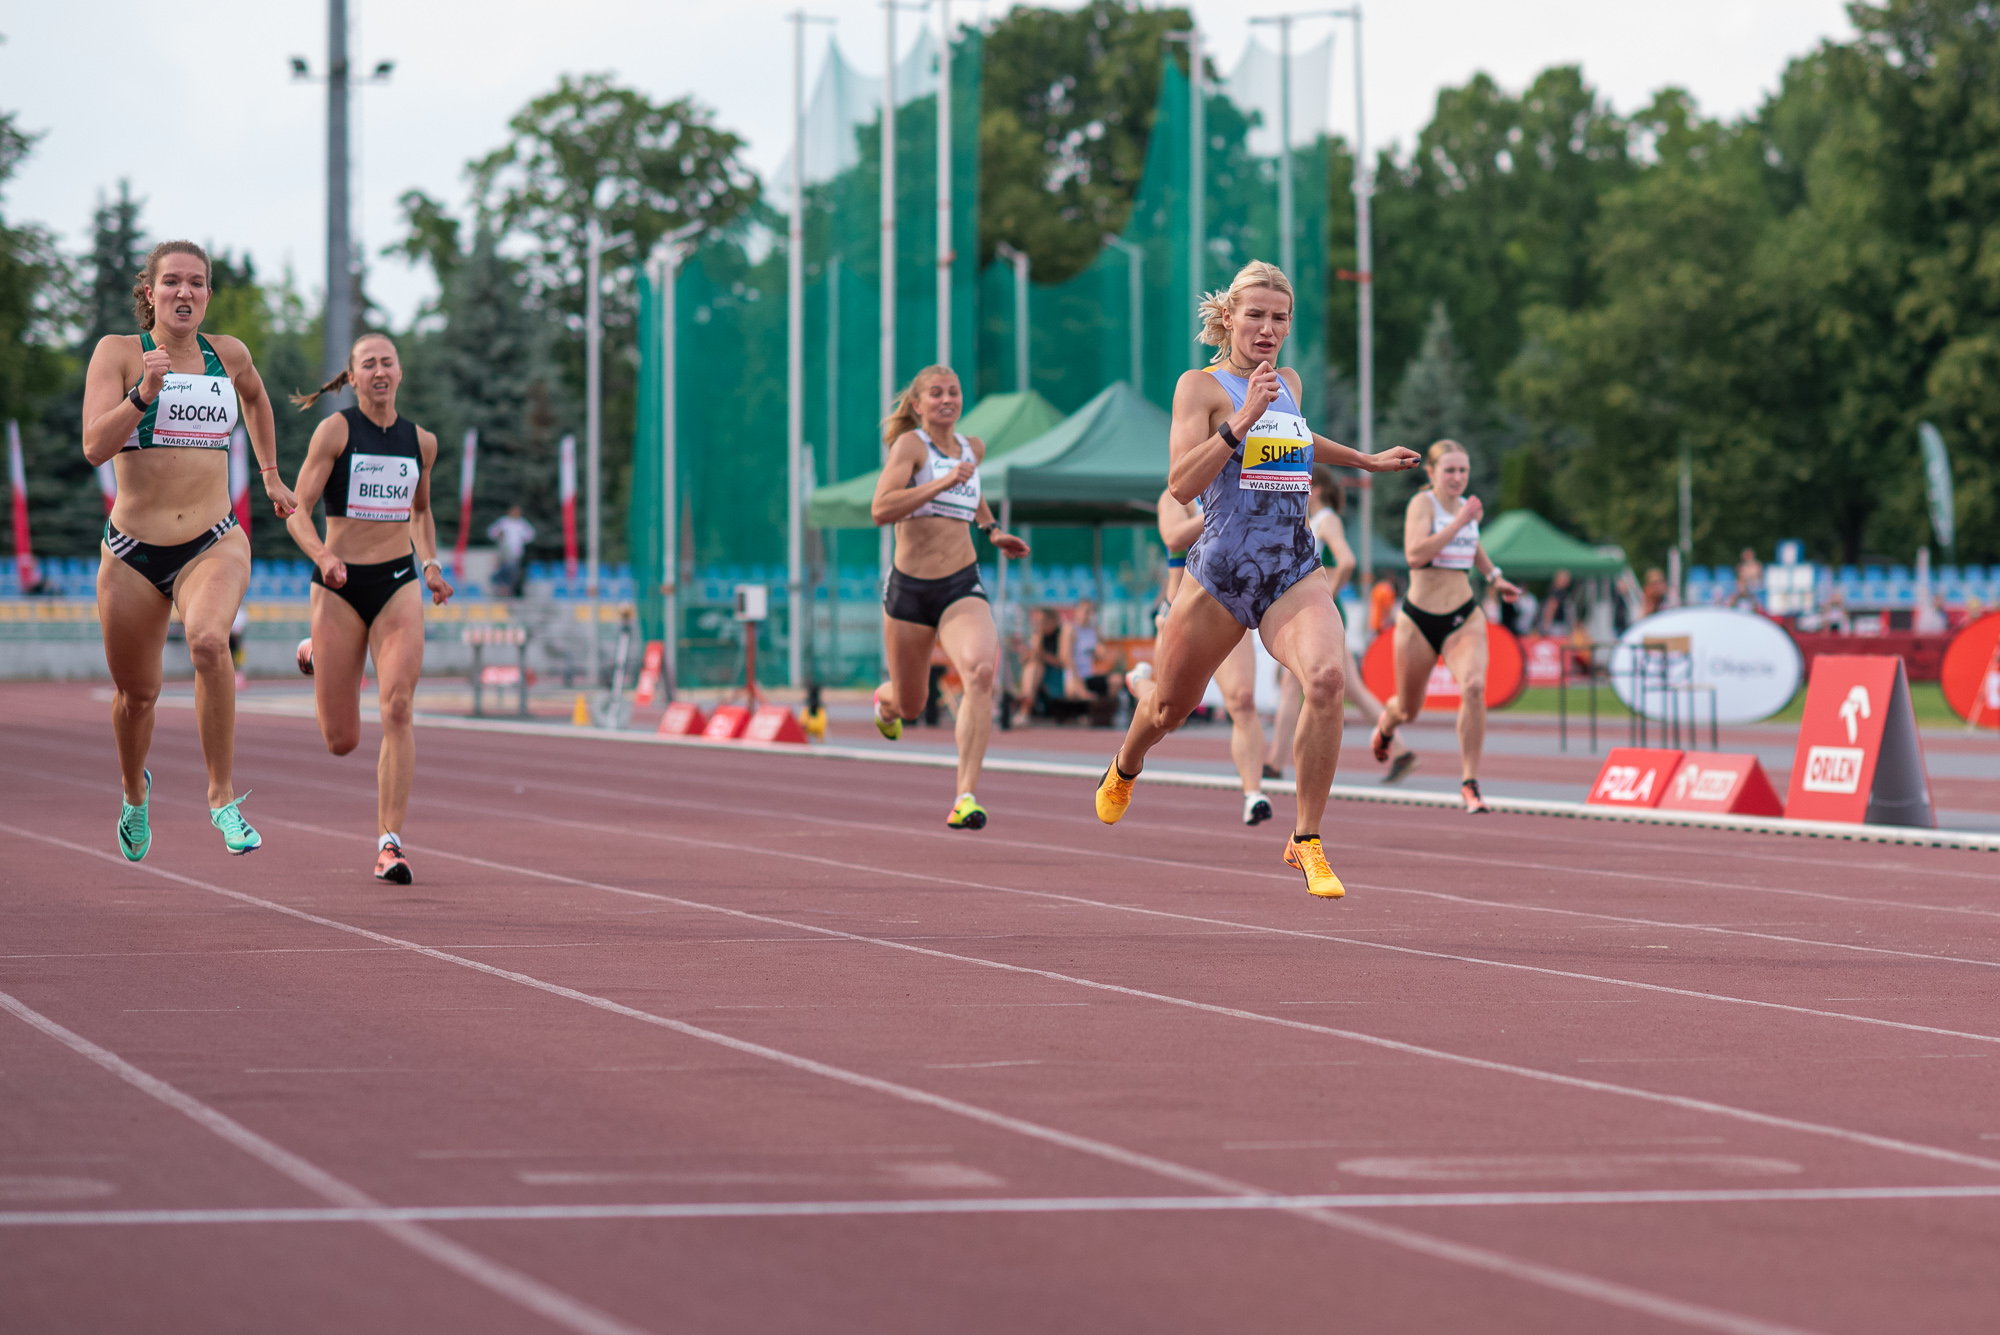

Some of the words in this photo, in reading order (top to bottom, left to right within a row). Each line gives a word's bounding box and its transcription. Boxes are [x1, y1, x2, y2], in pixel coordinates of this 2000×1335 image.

[211, 381, 221, 396] 4
[168, 404, 228, 422] SŁOCKA
[1293, 421, 1303, 437] 1
[162, 437, 208, 446] WARSZAWA
[400, 463, 408, 477] 3
[359, 483, 408, 499] BIELSKA
[1249, 481, 1300, 490] WARSZAWA
[355, 511, 394, 519] WARSZAWA
[1810, 756, 1857, 784] ORLEN
[1596, 766, 1657, 801] PZLA
